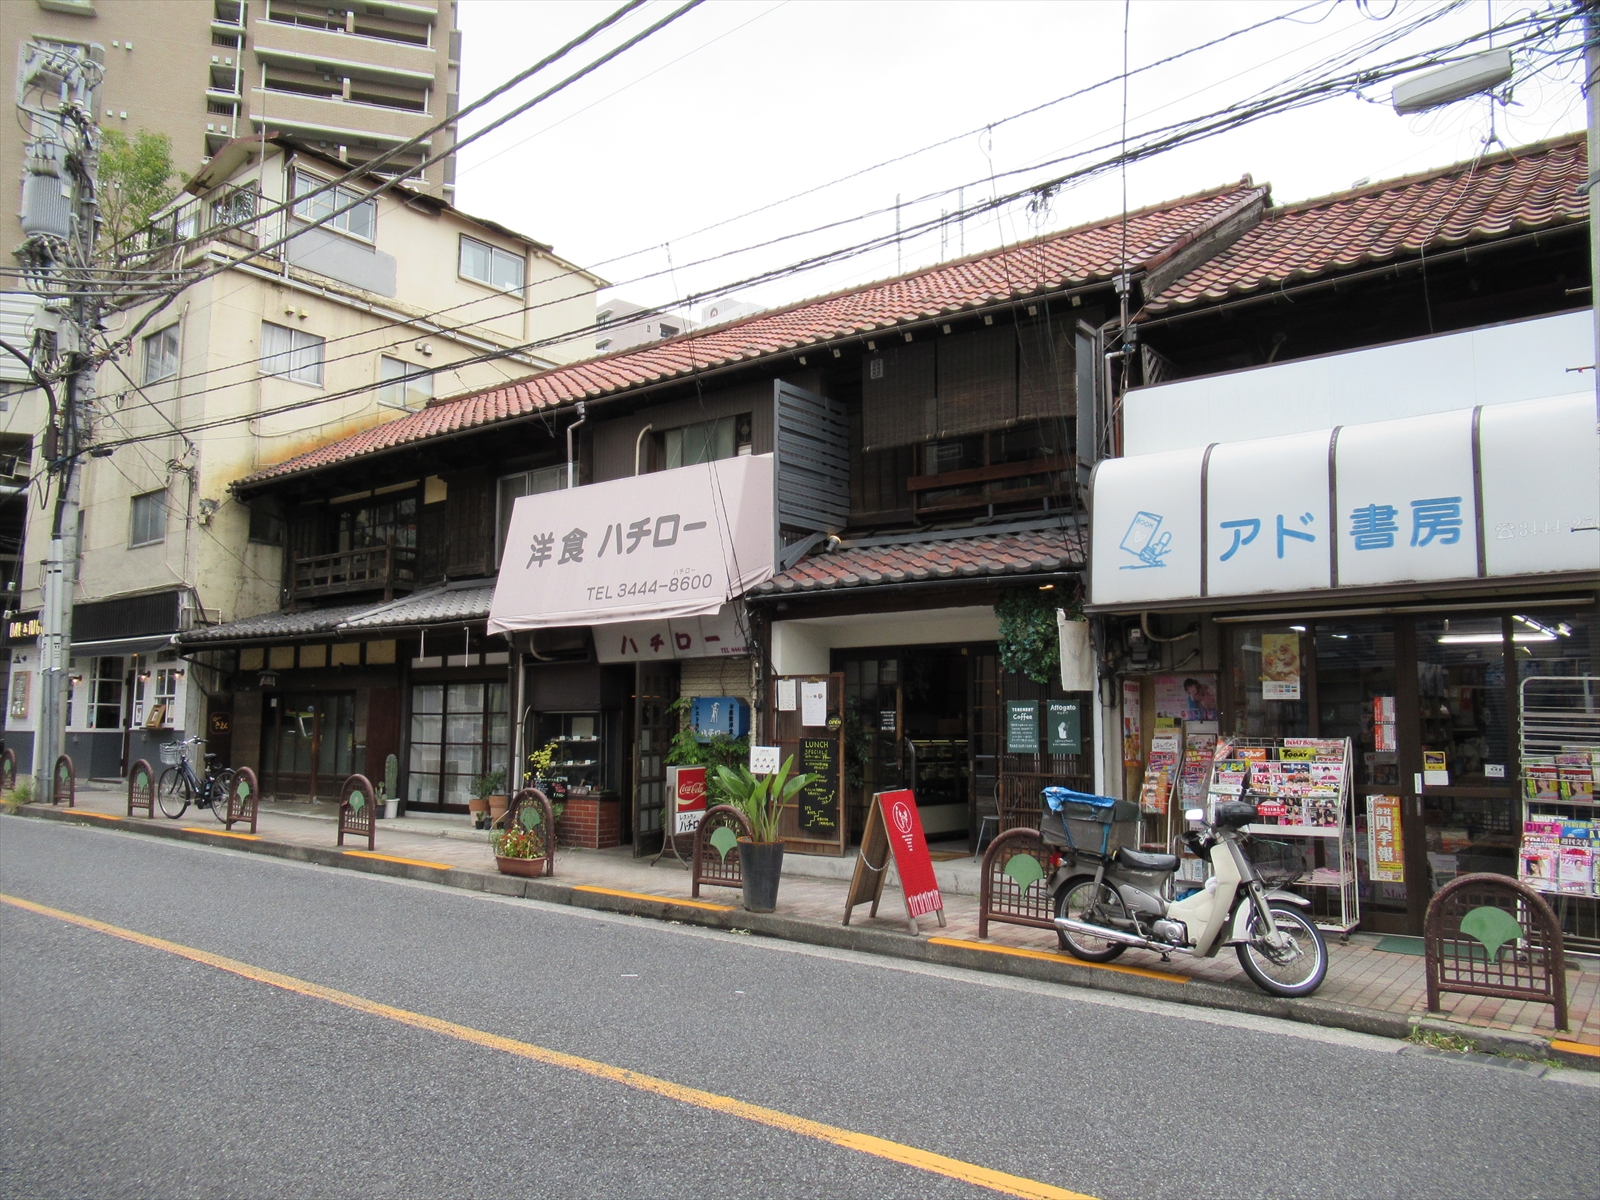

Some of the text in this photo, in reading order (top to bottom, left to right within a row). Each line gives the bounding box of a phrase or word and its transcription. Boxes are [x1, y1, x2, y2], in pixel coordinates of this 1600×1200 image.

[1135, 517, 1155, 530] BOOK
[1219, 496, 1464, 561] アド 書房
[526, 514, 707, 569] 洋食 ハチロー
[587, 573, 712, 600] TEL 3444-8600
[621, 632, 721, 655] ハチロー
[680, 782, 704, 795] Coca-Cola
[1376, 807, 1391, 815] 会社
[679, 819, 699, 832] ハチロ
[1375, 816, 1393, 862] 四季報
